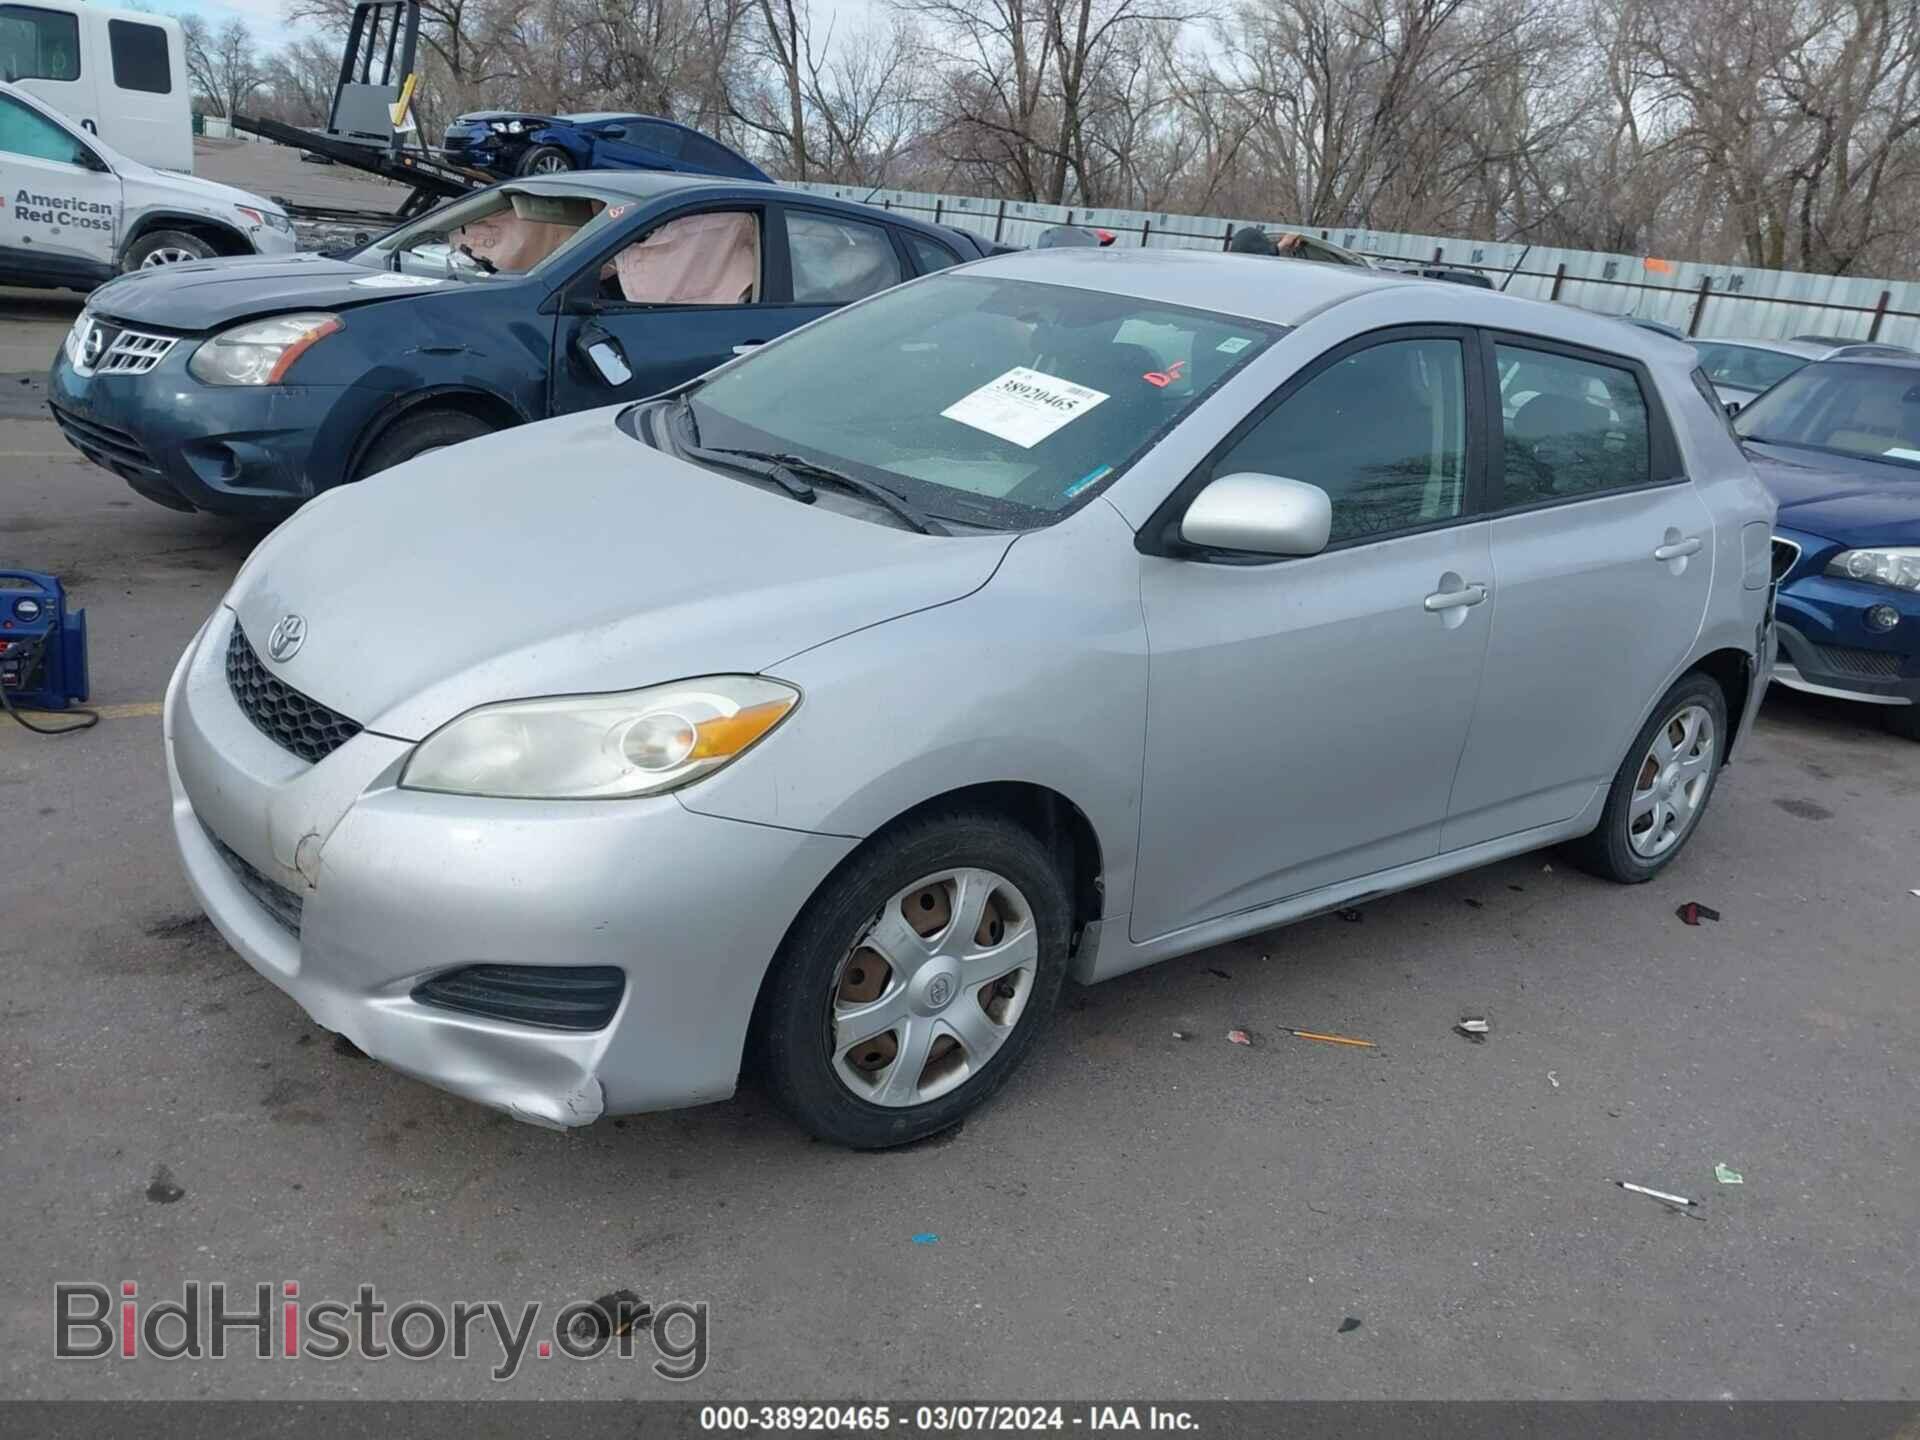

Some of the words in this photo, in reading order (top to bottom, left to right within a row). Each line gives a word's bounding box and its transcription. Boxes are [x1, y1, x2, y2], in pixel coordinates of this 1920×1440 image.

[15, 189, 112, 216] American
[15, 205, 54, 224] Red
[57, 211, 112, 232] Cross
[996, 380, 1080, 411] 38920465
